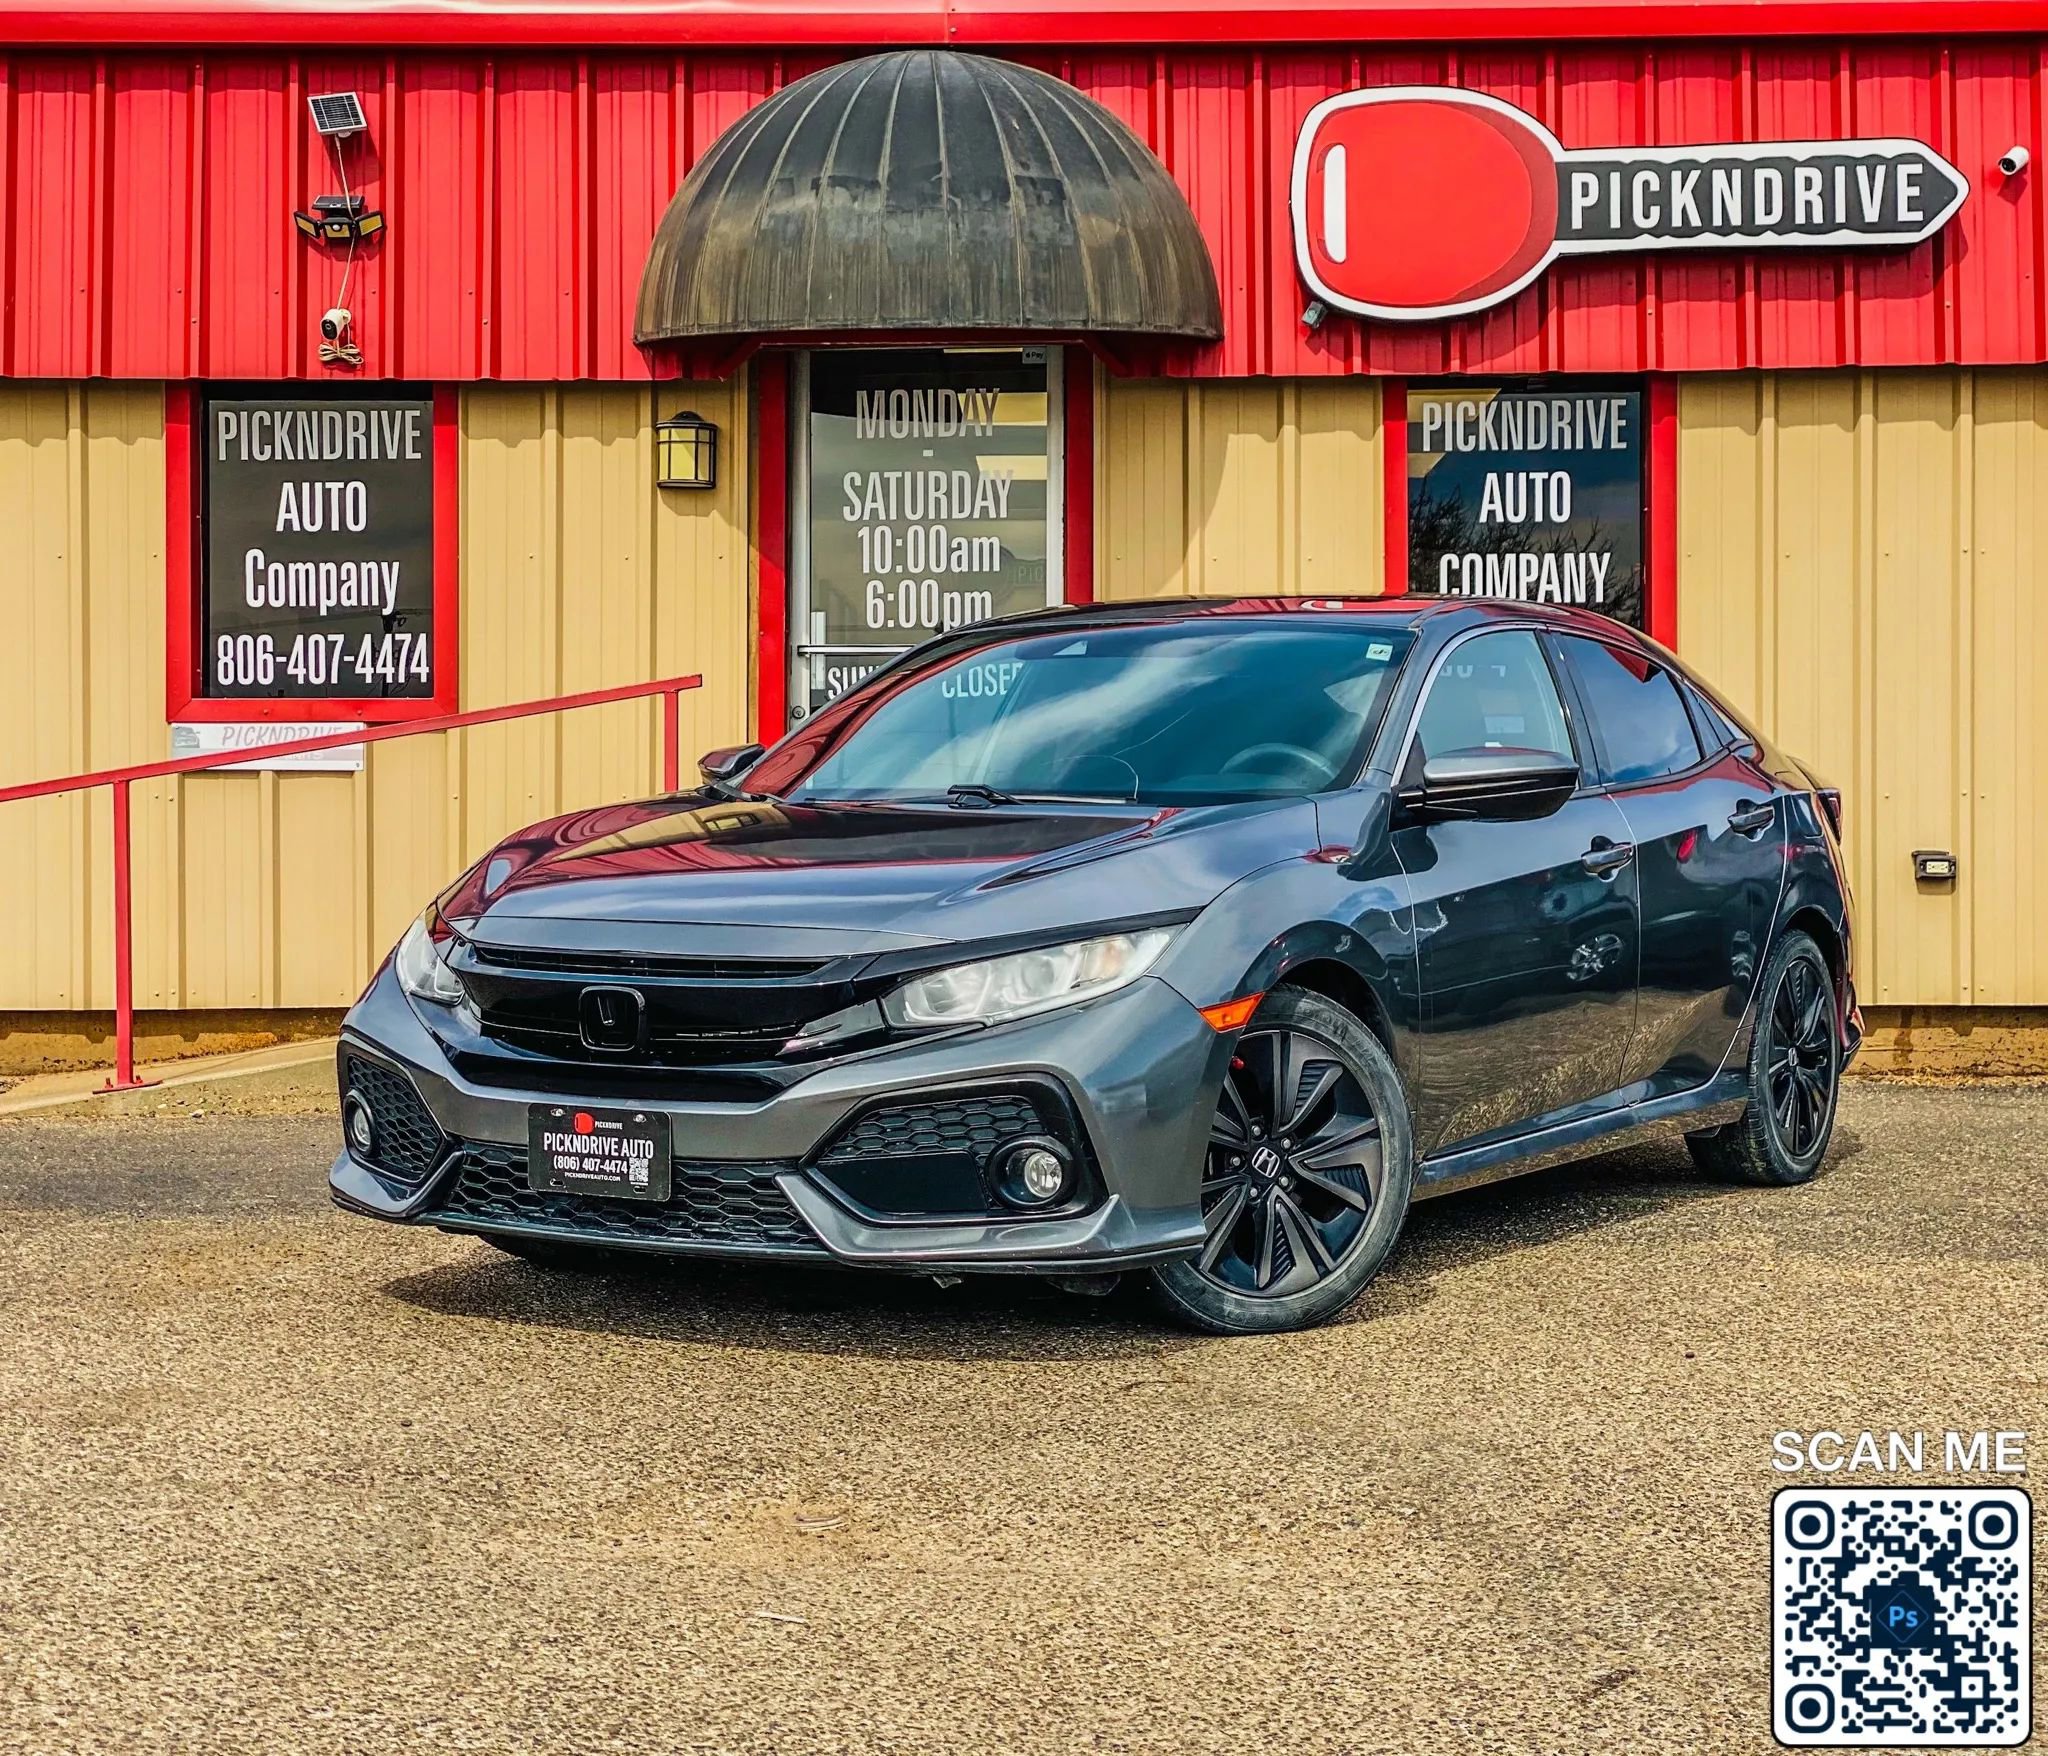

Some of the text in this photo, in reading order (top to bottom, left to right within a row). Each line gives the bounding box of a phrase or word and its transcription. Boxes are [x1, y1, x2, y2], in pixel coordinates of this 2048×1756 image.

[1570, 163, 1924, 231] PICKNDRIVE
[218, 410, 422, 461] PICKNDRIVE
[856, 388, 1000, 439] MONDAY
[1422, 399, 1627, 452] PICKNDRIVE
[275, 481, 367, 532] AUTO
[842, 470, 1014, 521] SATURDAY
[1479, 471, 1571, 523] AUTO
[857, 524, 1000, 574] 10:00am
[245, 548, 400, 616] Company
[1439, 552, 1611, 604] COMPANY
[866, 579, 993, 632] 6:00pm
[217, 633, 430, 686] 806-407-4474
[543, 1132, 654, 1159] PICKNDRIVE AUTO
[594, 1120, 623, 1130] PICKNDRIVE
[553, 1154, 628, 1174] (806) 407-4474
[564, 1171, 621, 1182] PICKNDRIVEAUTO.COM
